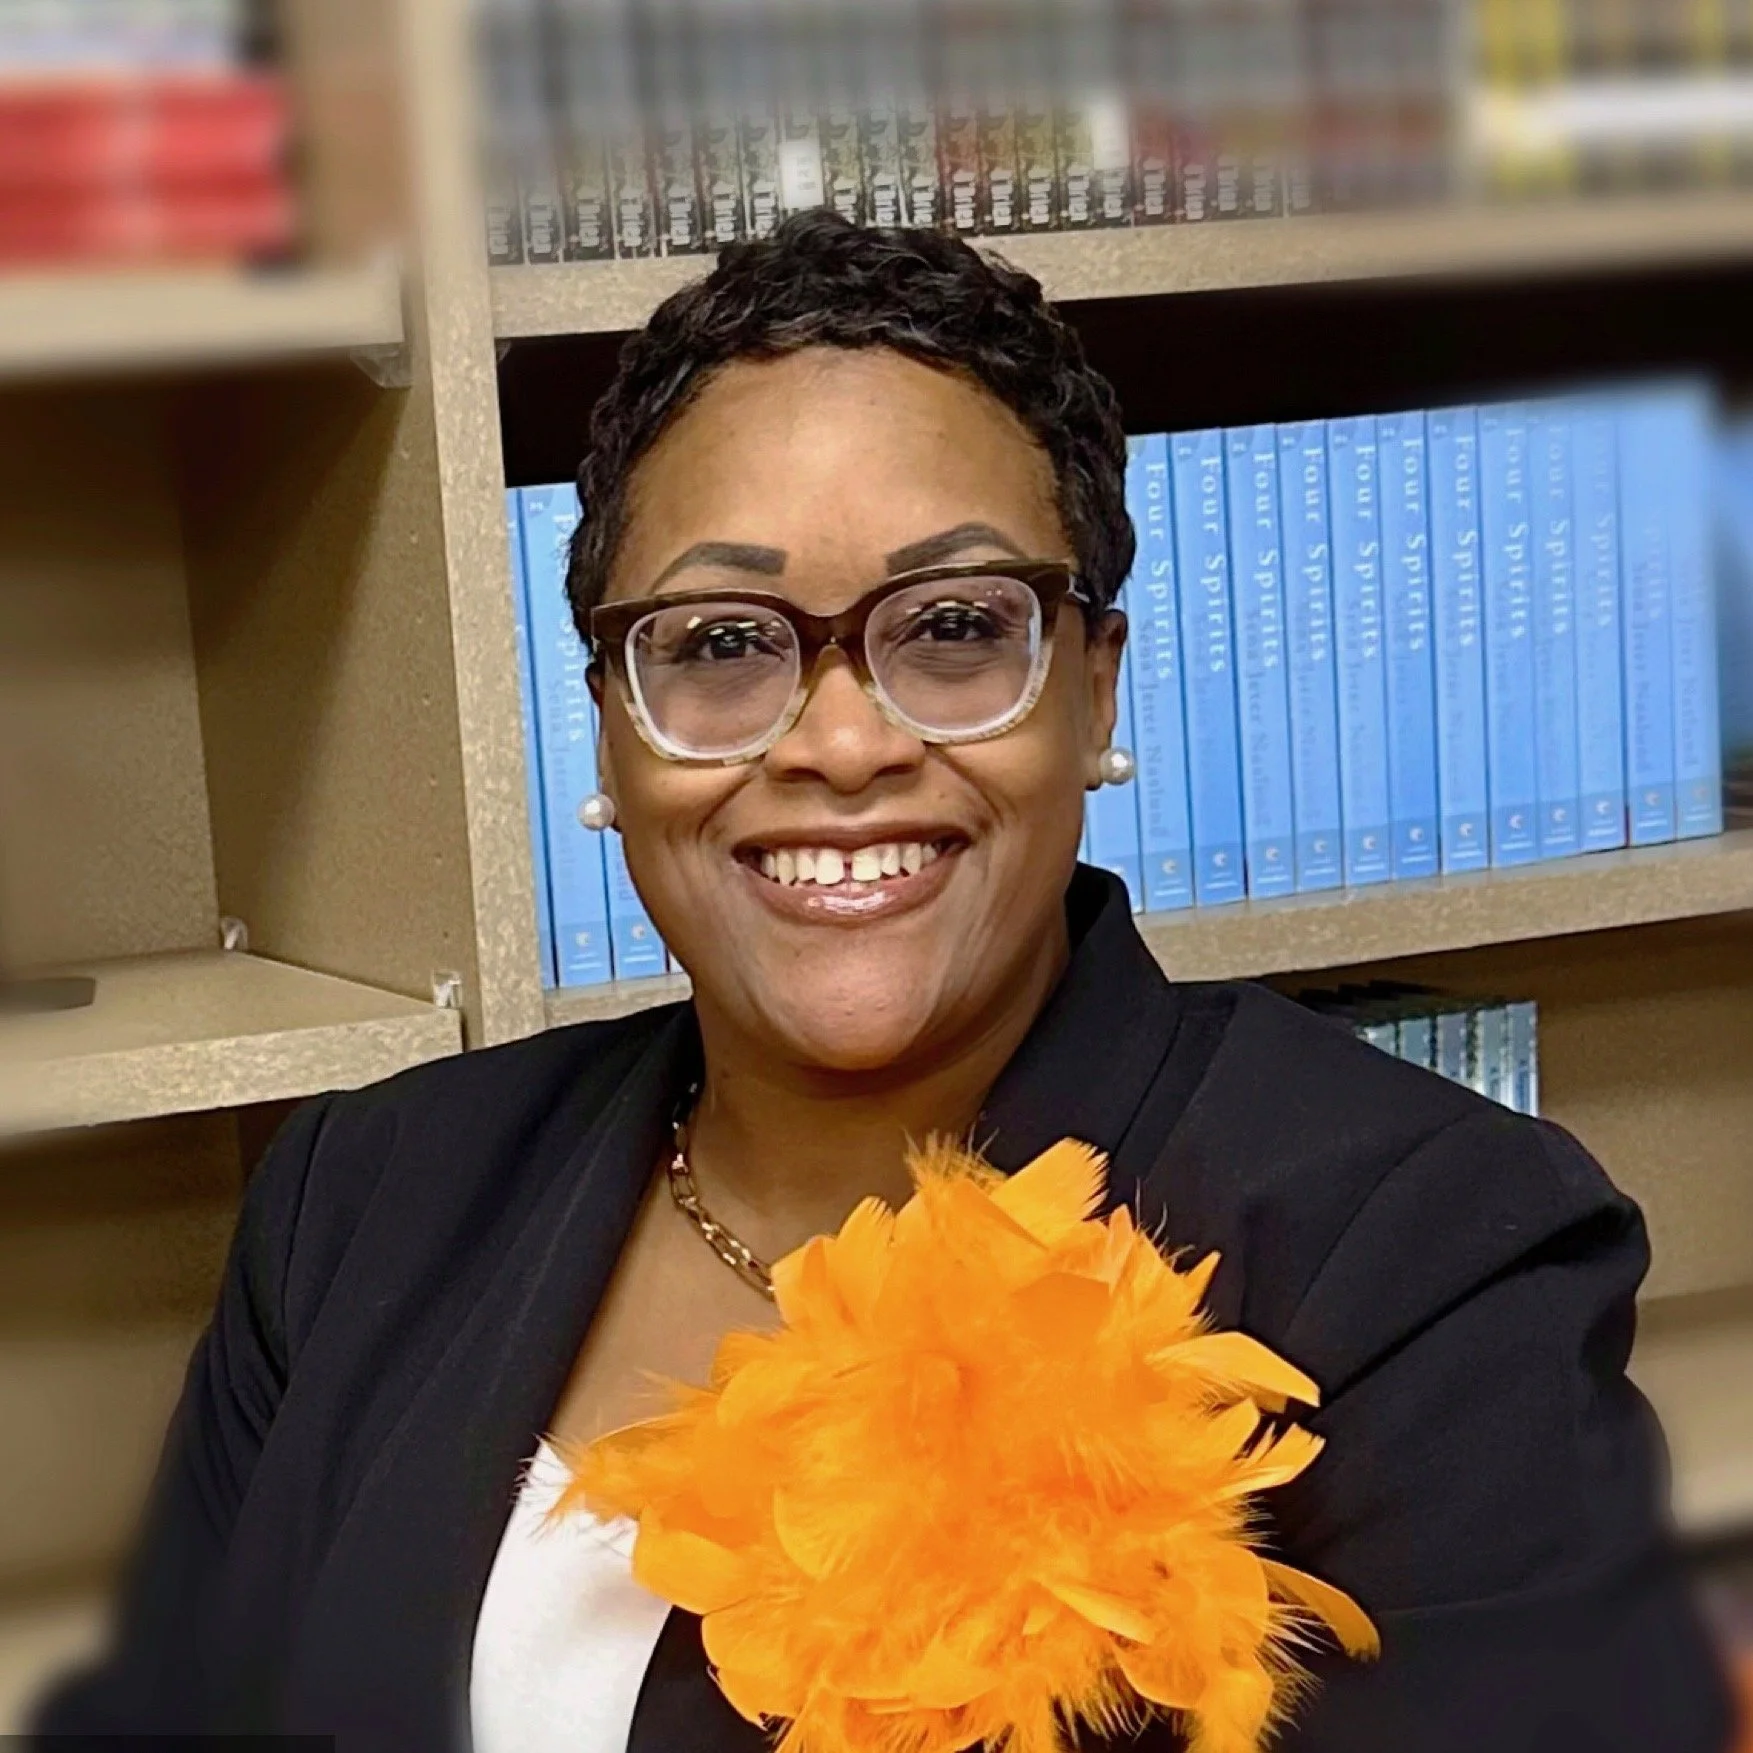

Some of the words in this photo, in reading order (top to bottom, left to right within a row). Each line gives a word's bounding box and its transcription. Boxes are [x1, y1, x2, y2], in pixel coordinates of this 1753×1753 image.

[1145, 462, 1168, 539] Four
[1200, 455, 1222, 535] Four
[1253, 451, 1275, 529] Four
[1302, 446, 1324, 523] Four
[1355, 444, 1377, 520] Four
[1403, 437, 1425, 515] Four
[1454, 435, 1476, 509] Four
[1146, 558, 1175, 679] Spirits
[1199, 553, 1228, 673] Spirits
[1253, 547, 1281, 668] Spirits
[1302, 542, 1329, 661] Spirits
[1353, 540, 1380, 659] Spirits
[1400, 532, 1428, 652] Spirits
[1452, 528, 1479, 648] Spirits
[1503, 521, 1530, 639] Spirits
[1546, 518, 1571, 636] Spirits
